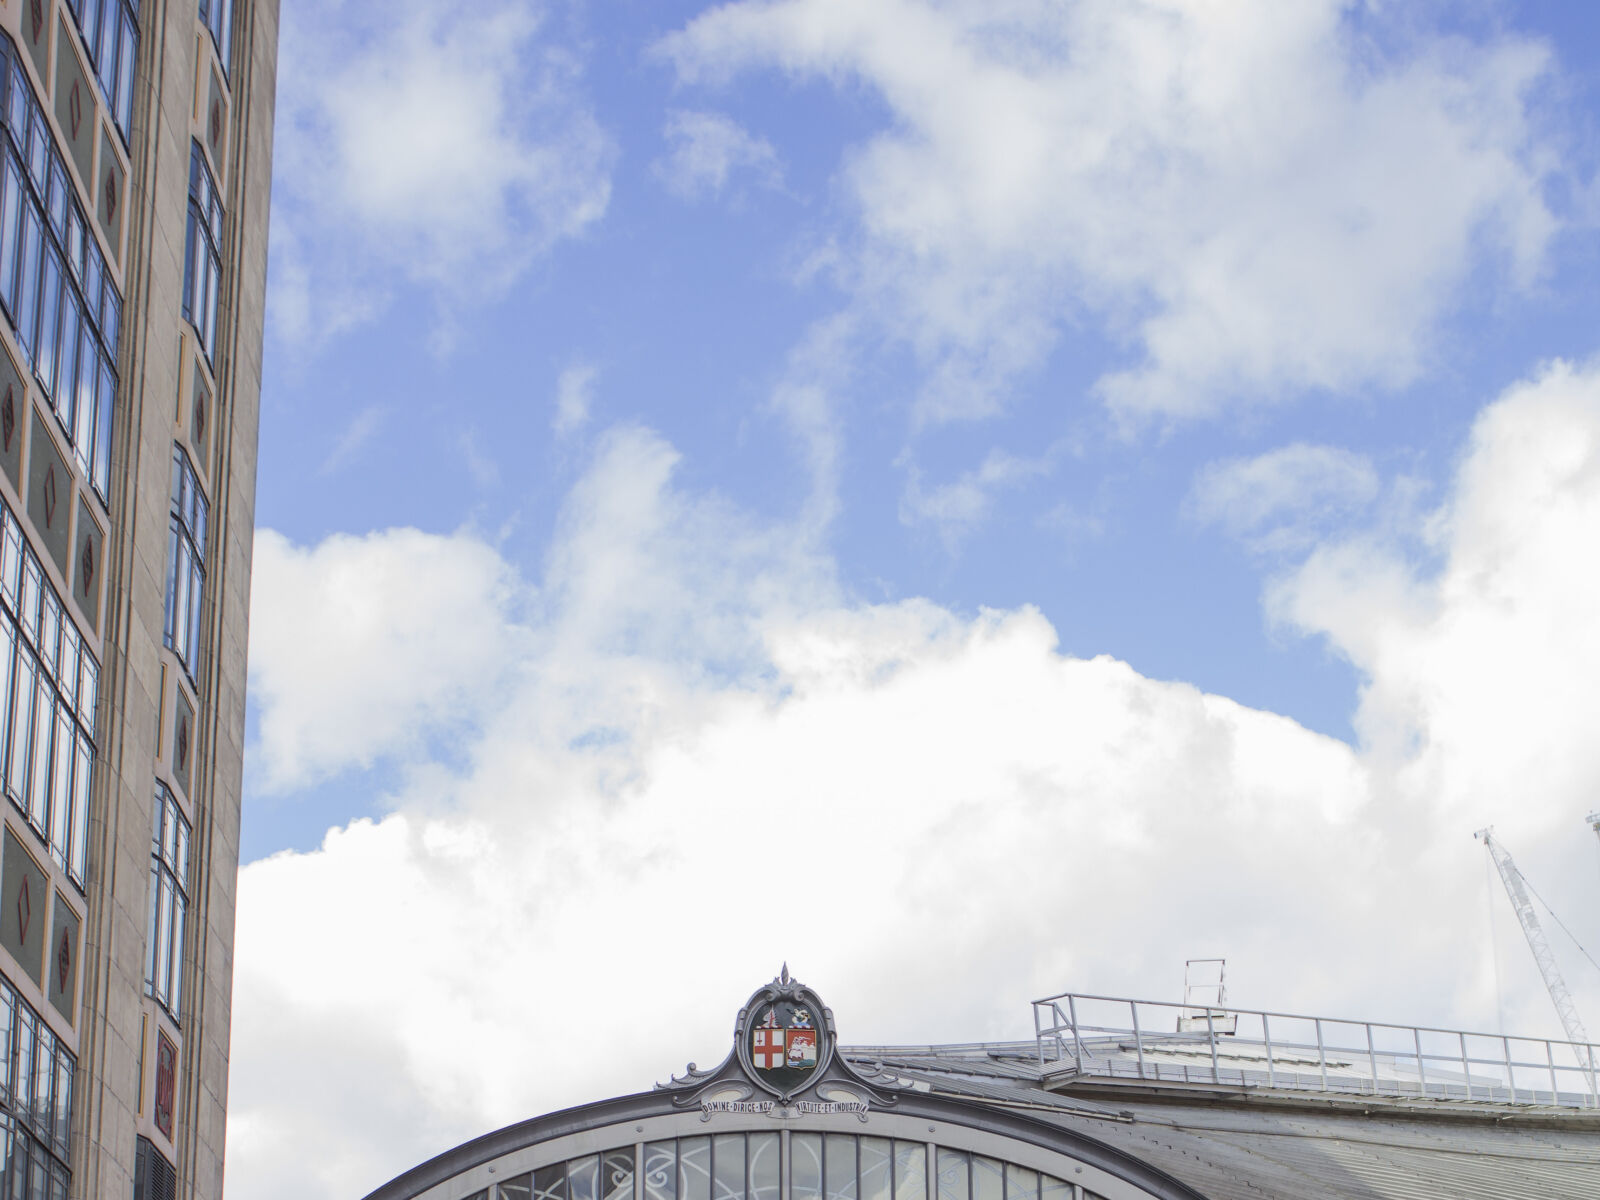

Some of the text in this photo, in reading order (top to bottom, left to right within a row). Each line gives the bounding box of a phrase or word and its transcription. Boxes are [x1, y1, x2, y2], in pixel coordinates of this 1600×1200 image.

[759, 1101, 773, 1112] NOS
[795, 1102, 867, 1114] VIRTUTE ET INDUSTRIA
